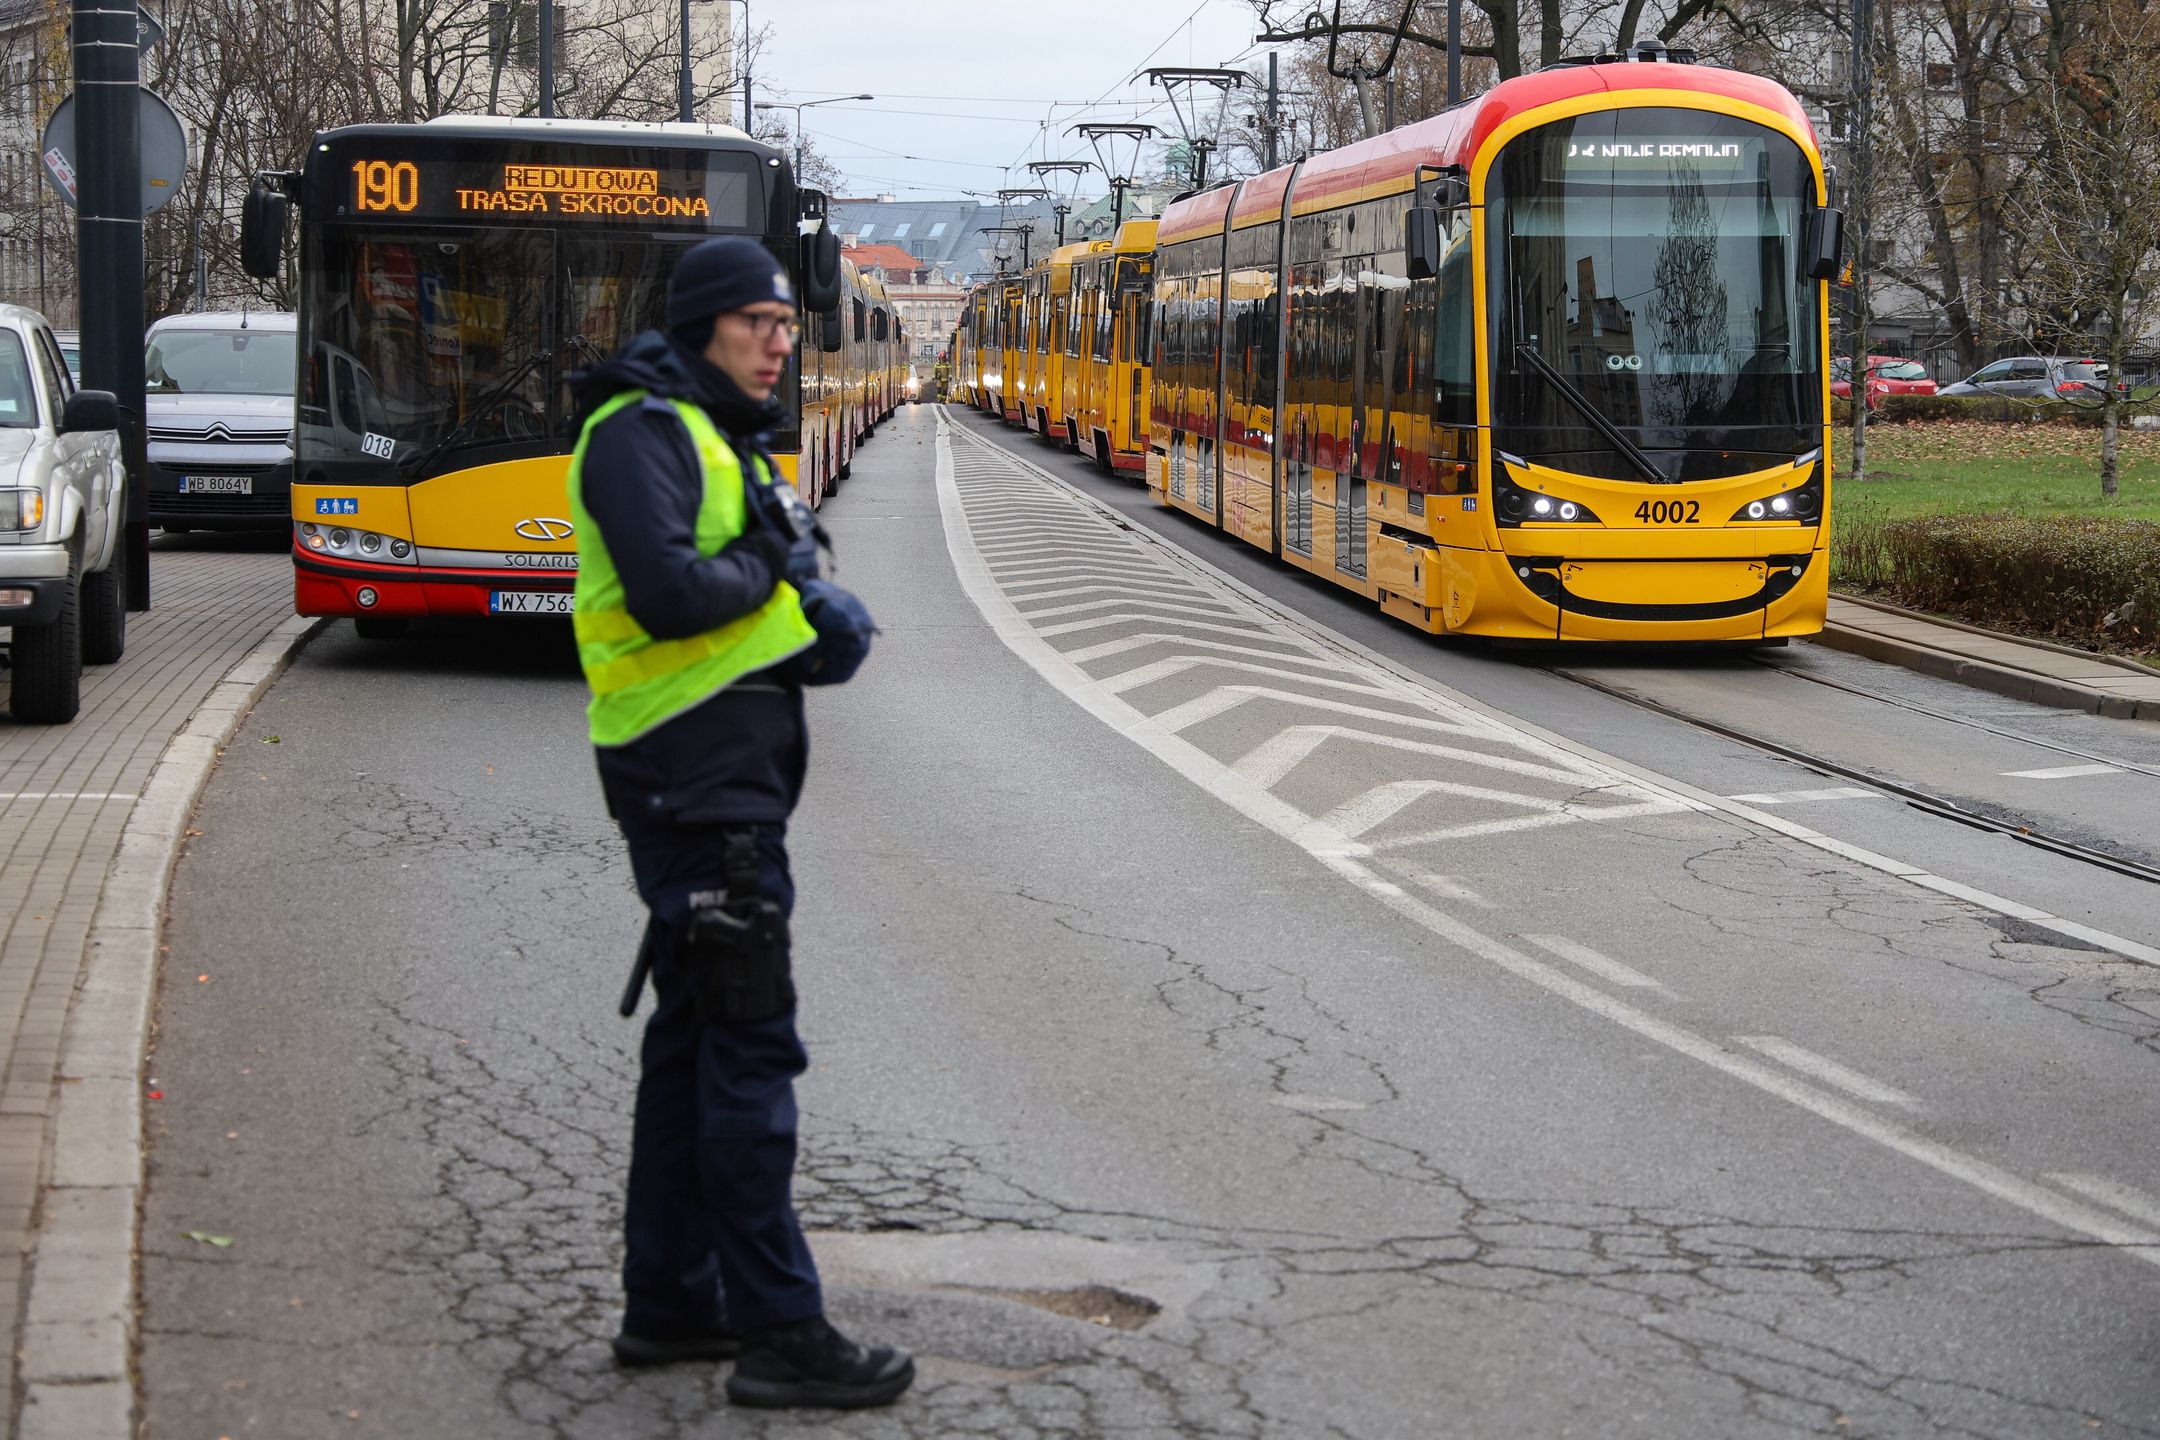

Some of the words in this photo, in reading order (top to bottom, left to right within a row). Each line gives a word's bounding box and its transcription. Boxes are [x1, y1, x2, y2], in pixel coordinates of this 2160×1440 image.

[352, 160, 418, 211] 190
[506, 167, 656, 192] REDUTOWA
[456, 189, 548, 212] TRASA
[363, 434, 393, 457] 018
[188, 478, 205, 490] WB
[210, 478, 249, 491] 8064Y
[1634, 500, 1700, 524] 4002
[504, 554, 579, 569] SOLARIS
[502, 594, 527, 611] WX
